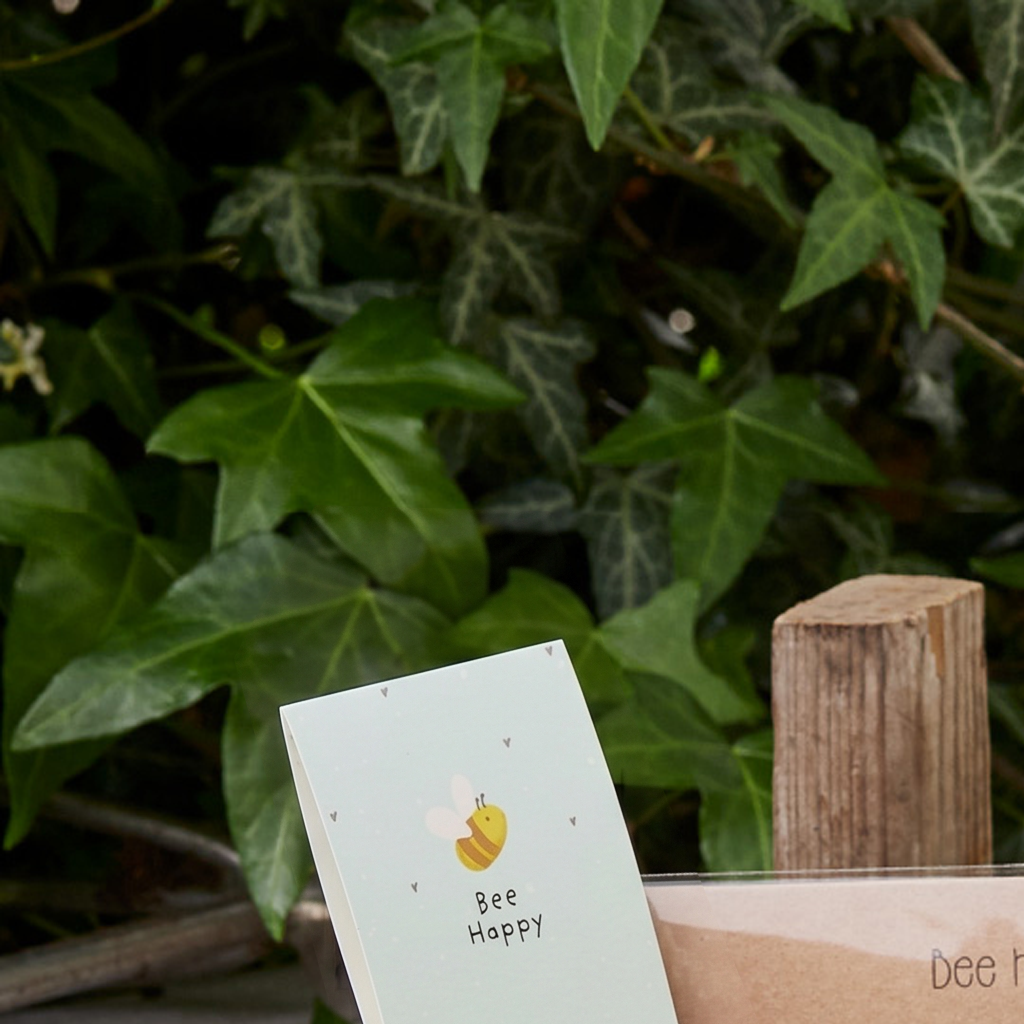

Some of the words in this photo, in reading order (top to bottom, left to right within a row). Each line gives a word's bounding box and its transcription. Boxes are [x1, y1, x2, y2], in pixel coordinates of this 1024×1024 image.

[475, 887, 518, 914] Bee
[468, 914, 544, 946] Happy
[930, 949, 997, 990] Bee
